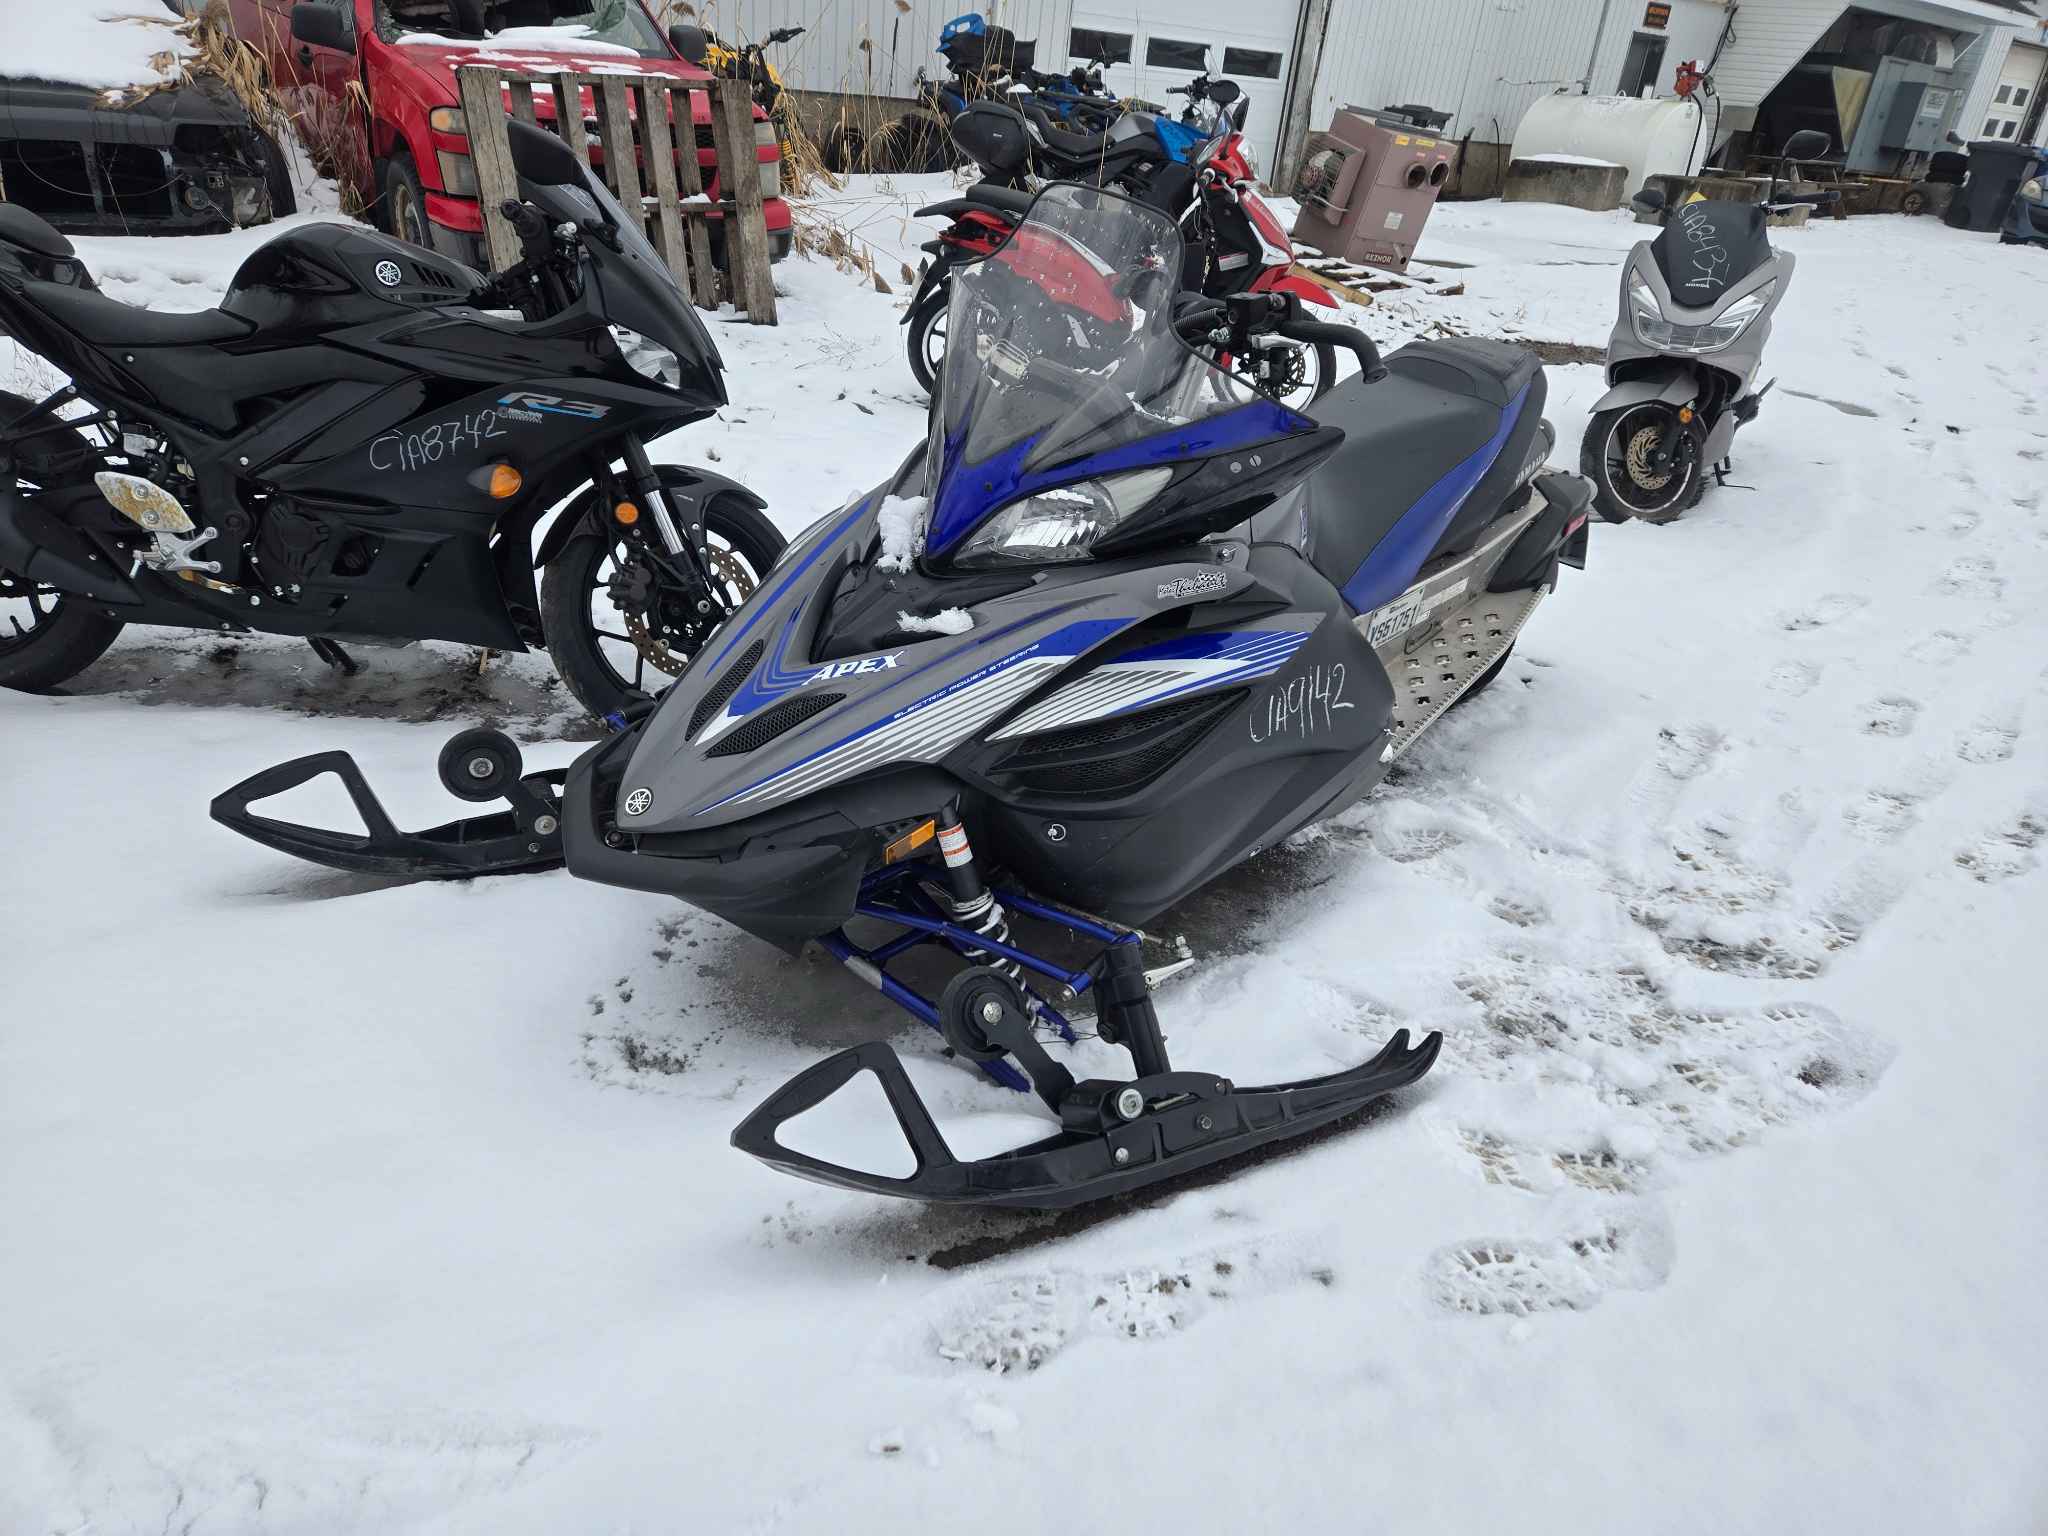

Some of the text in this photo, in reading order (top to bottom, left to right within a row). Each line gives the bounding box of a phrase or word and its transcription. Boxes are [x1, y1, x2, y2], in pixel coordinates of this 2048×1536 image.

[496, 391, 612, 419] R3
[801, 650, 904, 686] APEX
[894, 643, 1040, 719] ELECTRIC POWER STEERING
